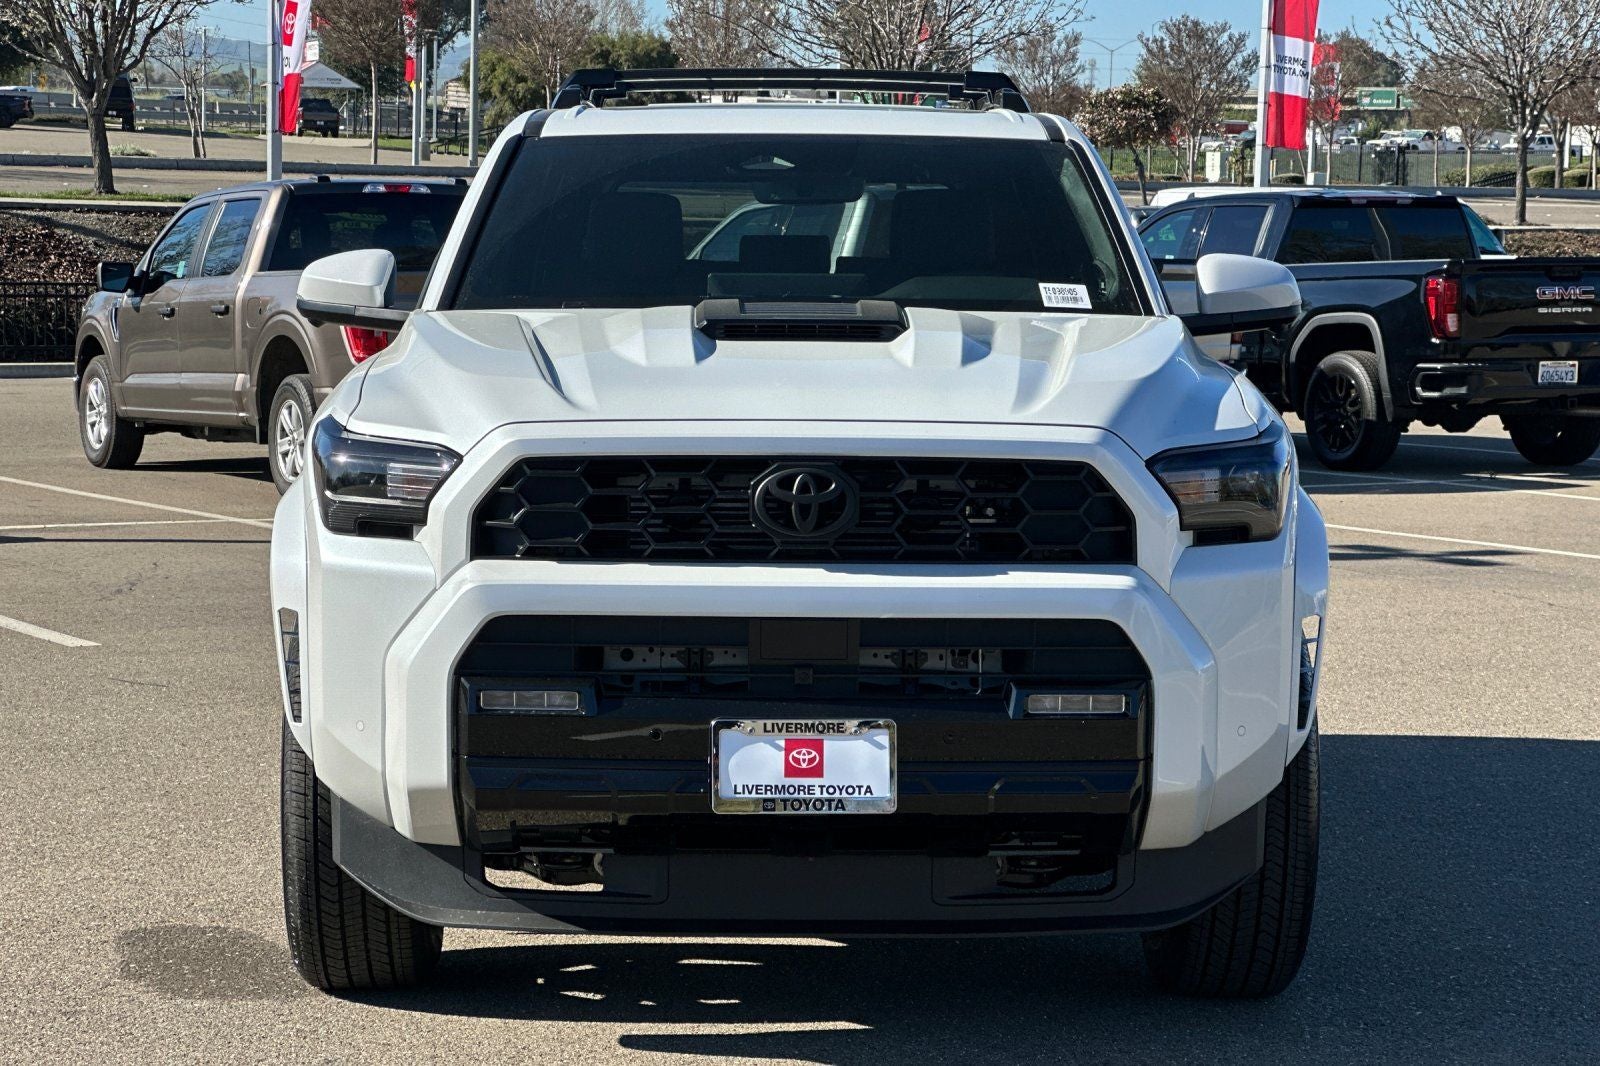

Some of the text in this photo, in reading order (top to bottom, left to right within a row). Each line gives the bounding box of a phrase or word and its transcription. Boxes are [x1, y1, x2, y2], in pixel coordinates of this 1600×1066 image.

[1536, 286, 1595, 300] GMC
[1541, 370, 1574, 382] 60654Y3
[763, 722, 846, 734] LIVERMORE
[734, 784, 874, 796] LIVERMORE TOYOTA
[781, 799, 846, 812] TOYOTA
